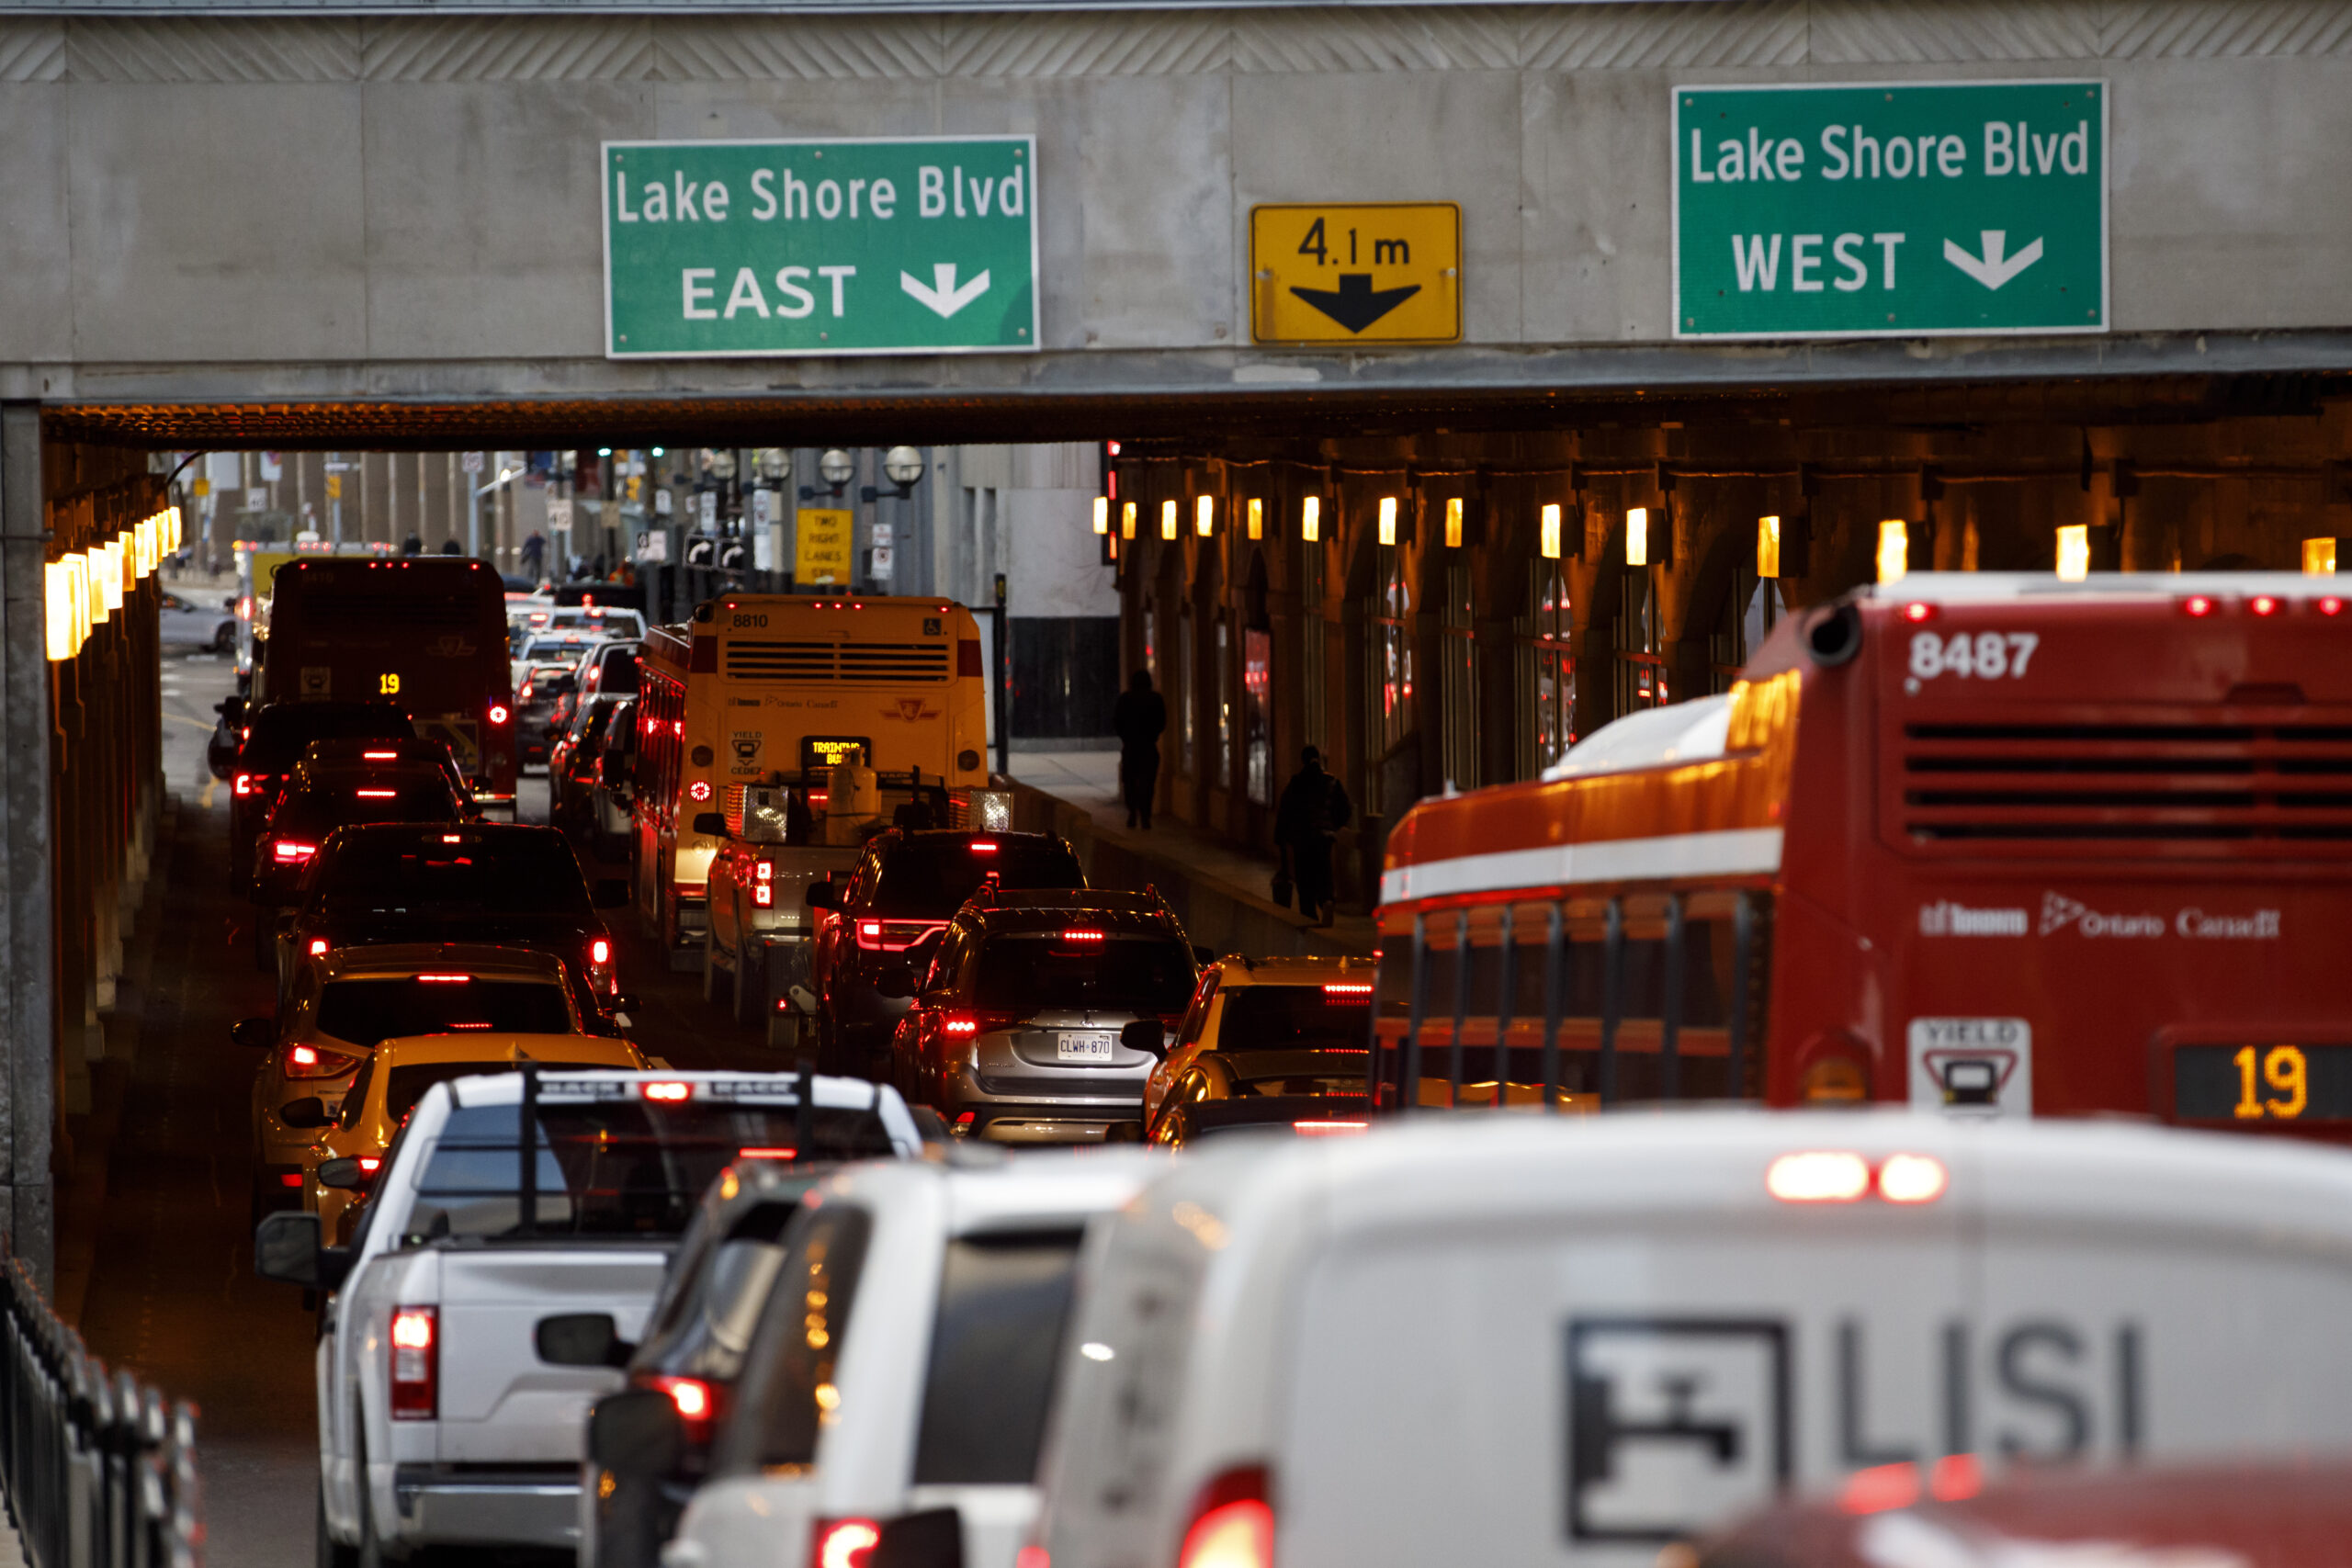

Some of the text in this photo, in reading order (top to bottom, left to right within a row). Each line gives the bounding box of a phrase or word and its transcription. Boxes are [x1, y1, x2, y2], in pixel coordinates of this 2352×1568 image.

[1690, 119, 2089, 185] Lake Shore Blvd
[616, 164, 1024, 222] Lake Shore Blvd
[1298, 217, 1411, 267] 4.1 m
[1731, 231, 1906, 292] WEST
[681, 265, 857, 320] EAST
[808, 533, 840, 544] RIGHT
[815, 516, 837, 526] TWO
[804, 551, 842, 562] LANES
[733, 615, 768, 628] 8810
[1909, 631, 2040, 678] 8487
[379, 672, 401, 695] 19
[1060, 1039, 1110, 1055] CLWH 870
[1925, 1021, 2018, 1046] YIELD
[2233, 1044, 2309, 1120] 19
[1833, 1315, 2147, 1464] LISI
